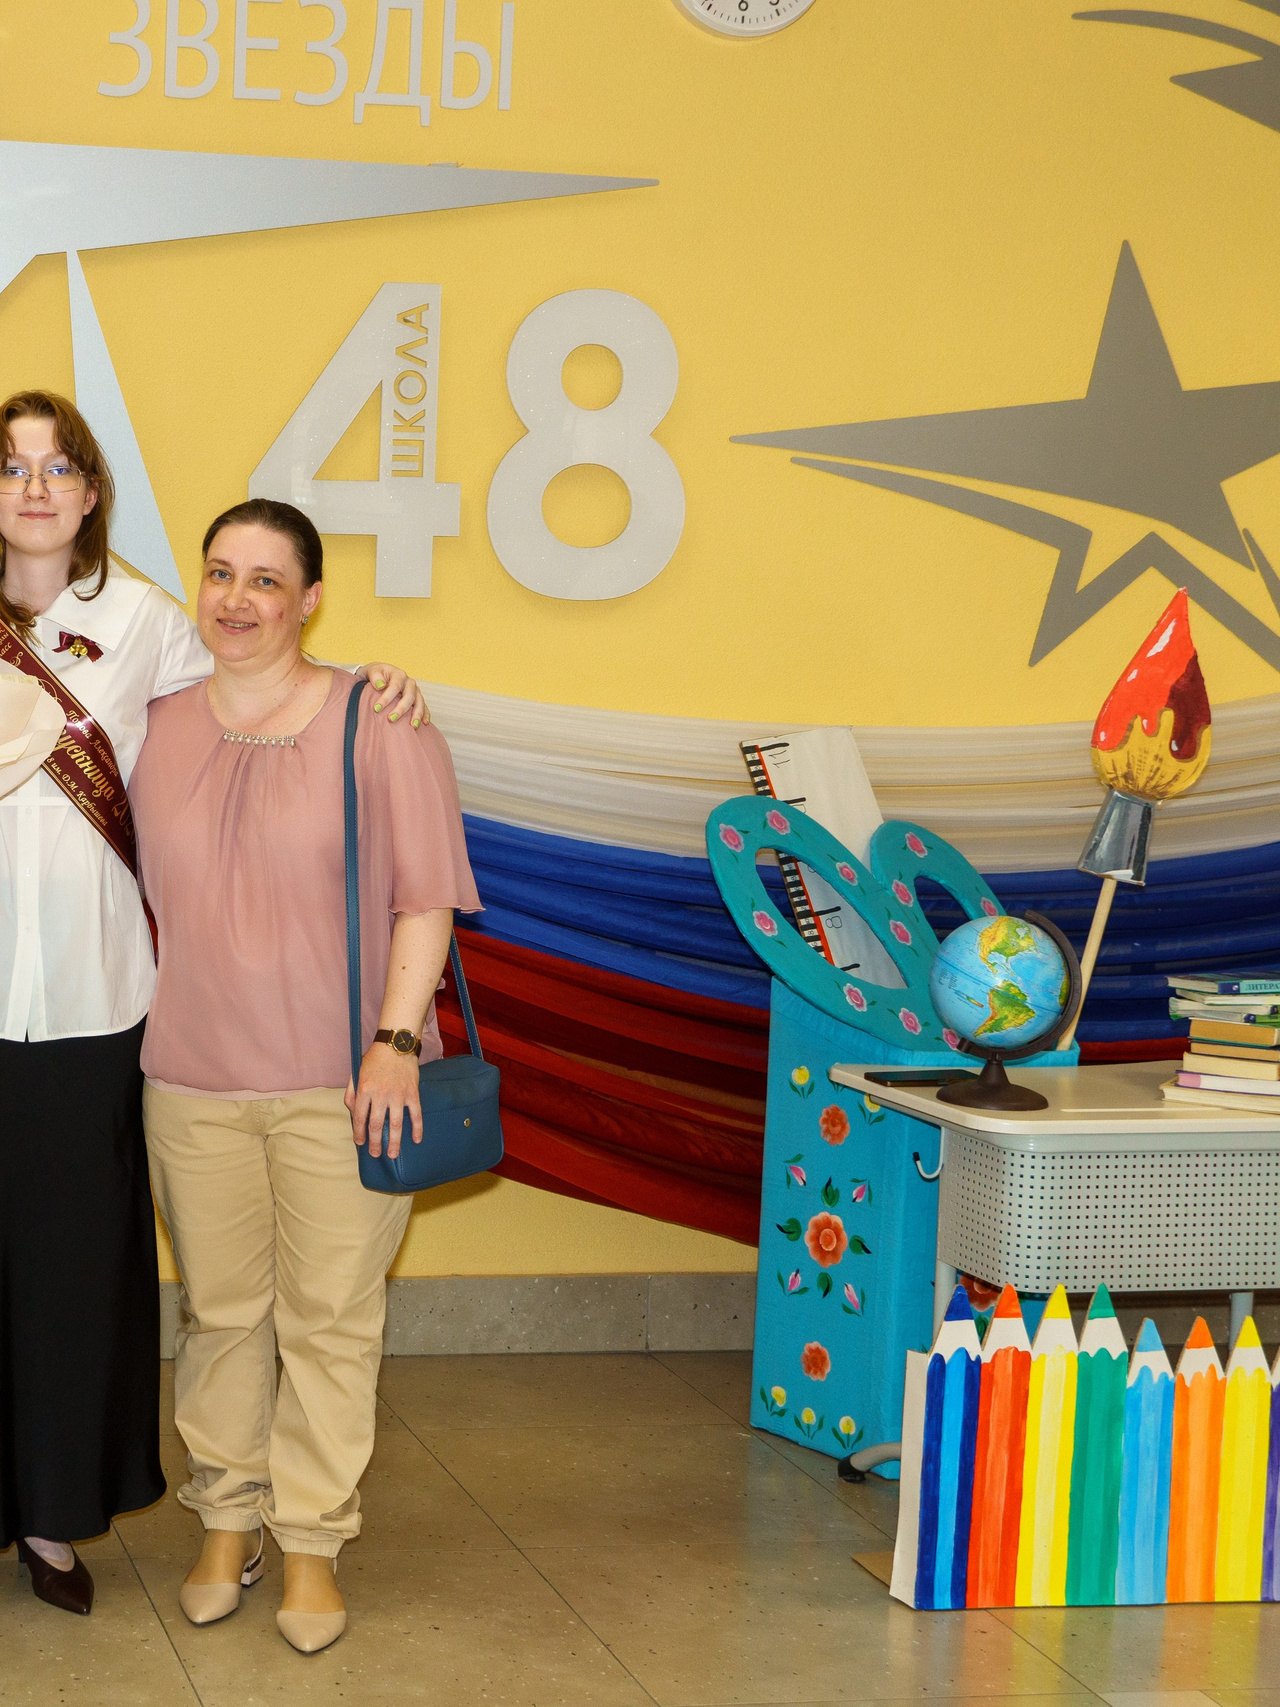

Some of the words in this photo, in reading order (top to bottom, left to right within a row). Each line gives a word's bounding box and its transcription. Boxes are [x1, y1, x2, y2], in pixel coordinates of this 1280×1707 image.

[97, 0, 515, 127] ЗВЕЗДЫ
[390, 302, 430, 478] ШКОЛА
[248, 282, 686, 601] 48
[53, 730, 115, 801] ускница
[66, 709, 92, 739] Попова
[90, 738, 119, 777] Александра
[76, 790, 108, 827] Карбышева
[825, 915, 843, 929] 8
[1245, 983, 1280, 991] ЛИТЕРА
